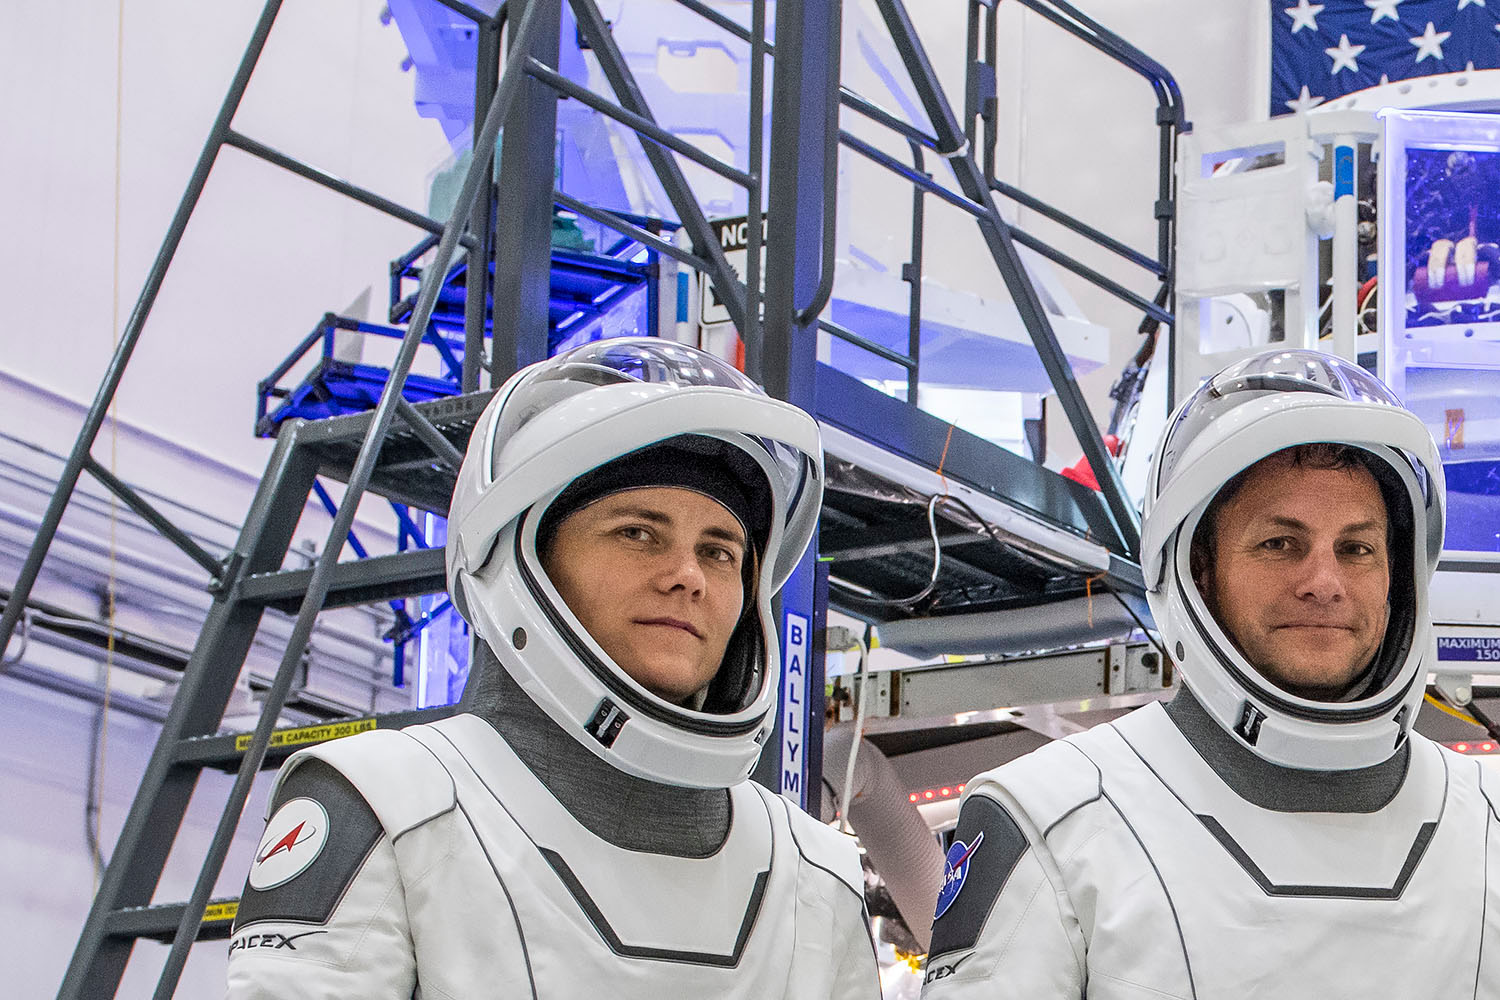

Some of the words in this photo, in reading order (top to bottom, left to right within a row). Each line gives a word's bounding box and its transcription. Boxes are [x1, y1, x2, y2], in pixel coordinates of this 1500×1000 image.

[1438, 638, 1500, 650] MAXIMUM
[784, 624, 802, 793] BALLYM
[286, 728, 331, 742] CAPACITY
